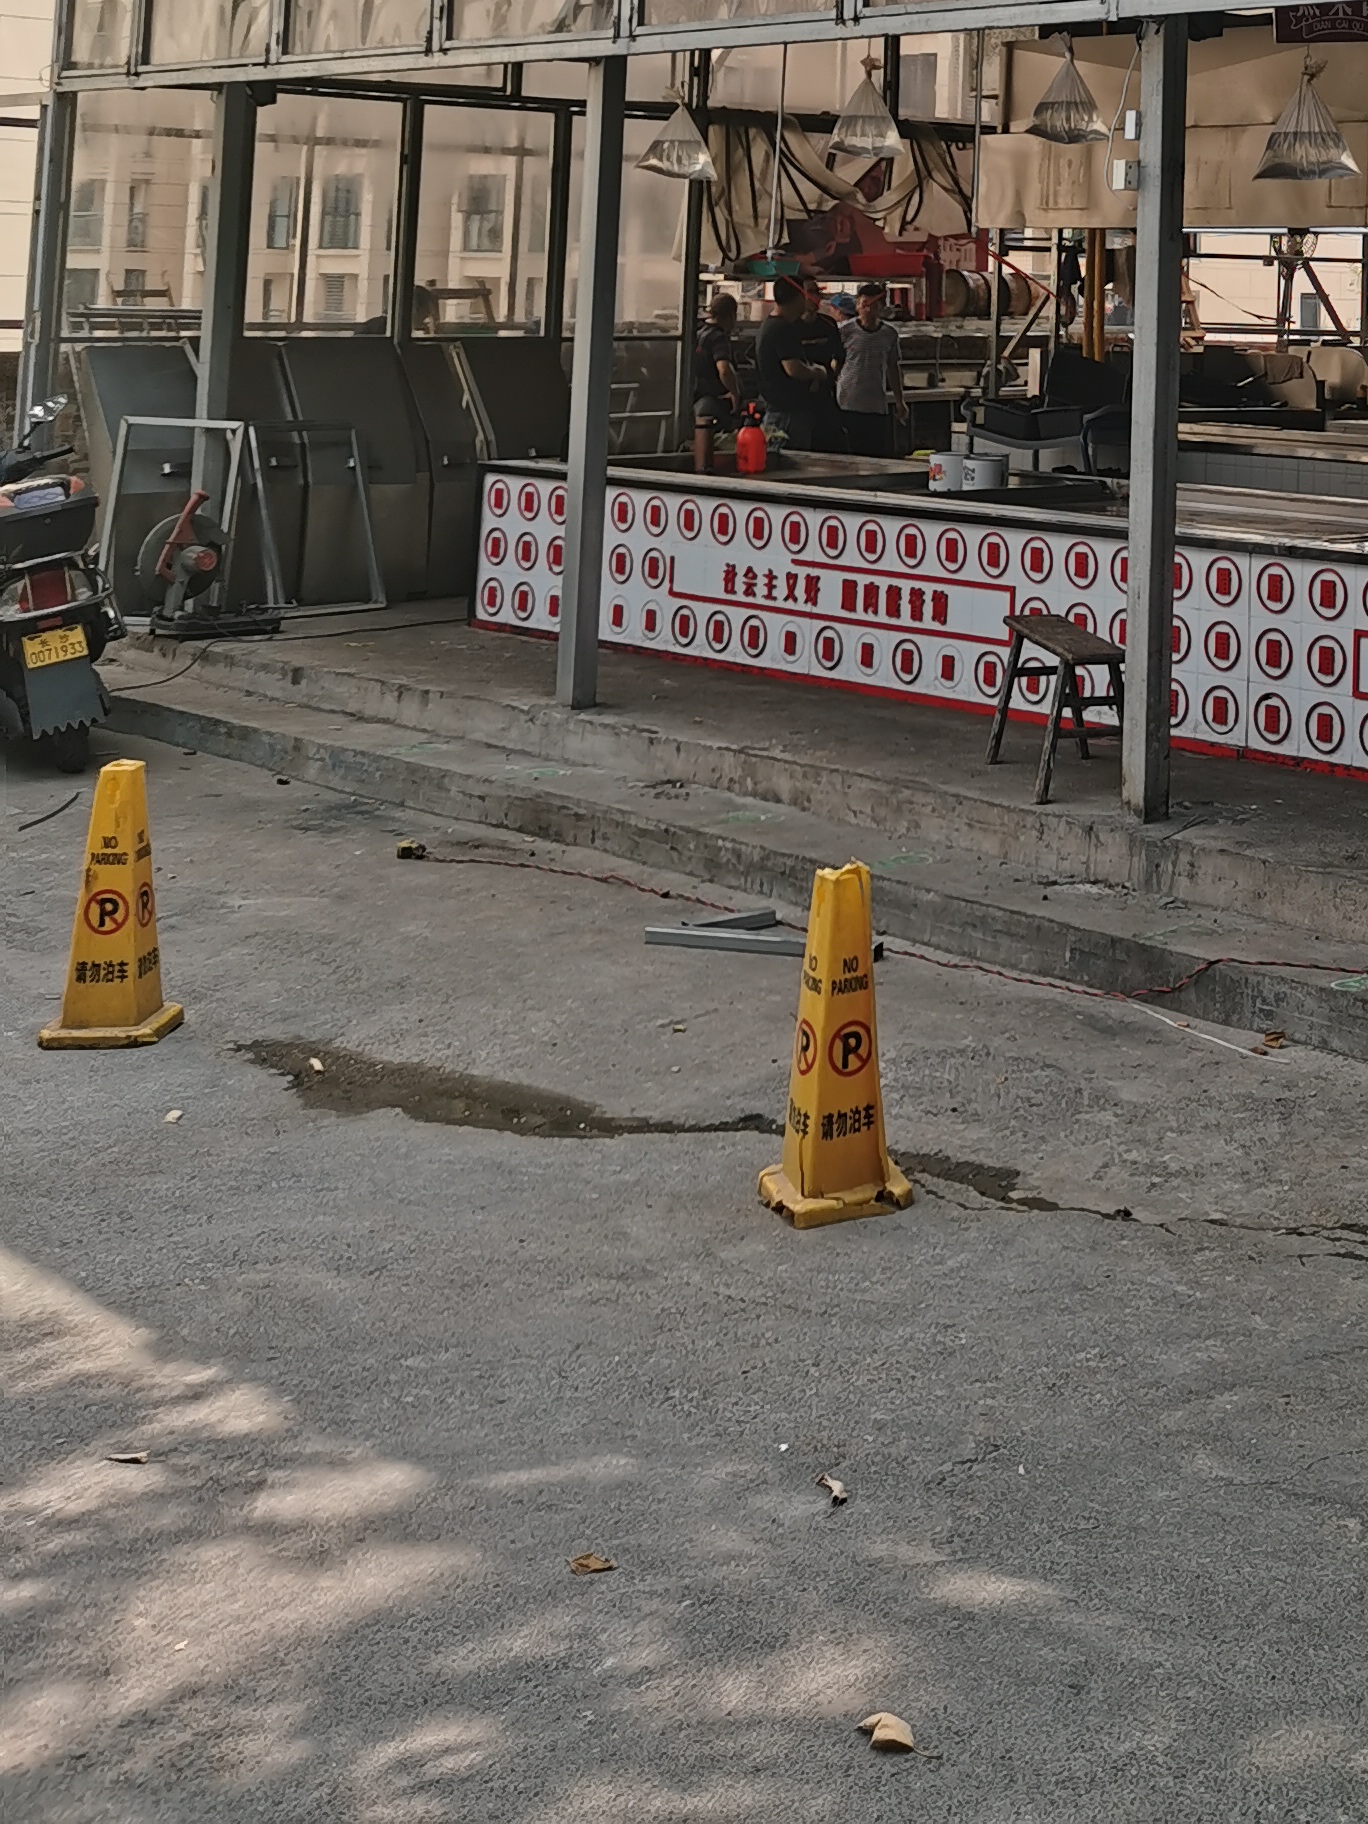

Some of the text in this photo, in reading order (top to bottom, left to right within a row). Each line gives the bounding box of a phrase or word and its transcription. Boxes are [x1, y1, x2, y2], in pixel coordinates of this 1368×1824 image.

[722, 561, 821, 608] 社会主义好
[30, 640, 85, 665] 0071933
[101, 835, 119, 850] NO
[90, 851, 129, 866] PARKING
[75, 959, 130, 984] 请勿泊车
[842, 954, 859, 975] NO
[831, 973, 869, 997] PARKING
[821, 1102, 875, 1142] 请勿泊车
